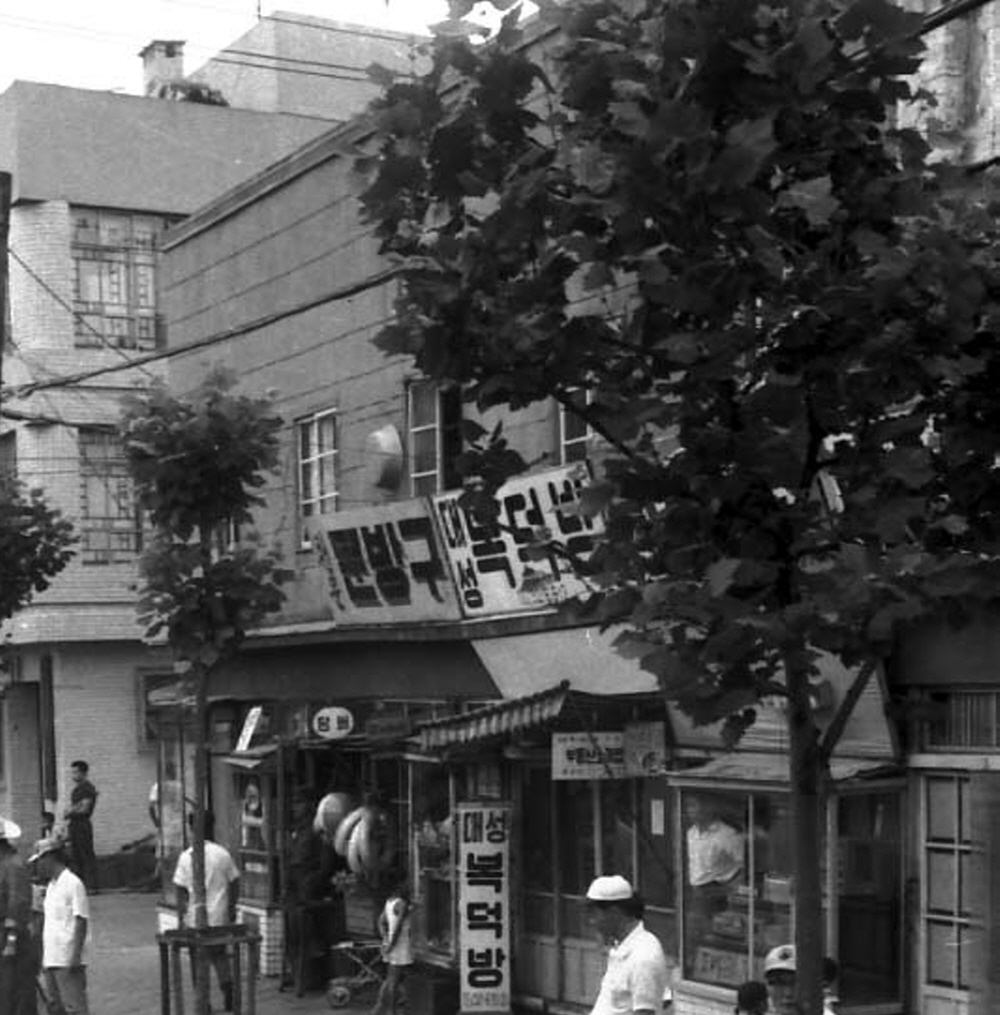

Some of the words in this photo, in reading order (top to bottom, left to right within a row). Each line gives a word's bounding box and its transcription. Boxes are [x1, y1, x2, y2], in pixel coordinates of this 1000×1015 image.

[438, 499, 484, 608] 대성
[463, 479, 597, 589] 복덕방
[463, 811, 506, 843] 대성
[466, 852, 507, 988] 복덕방
